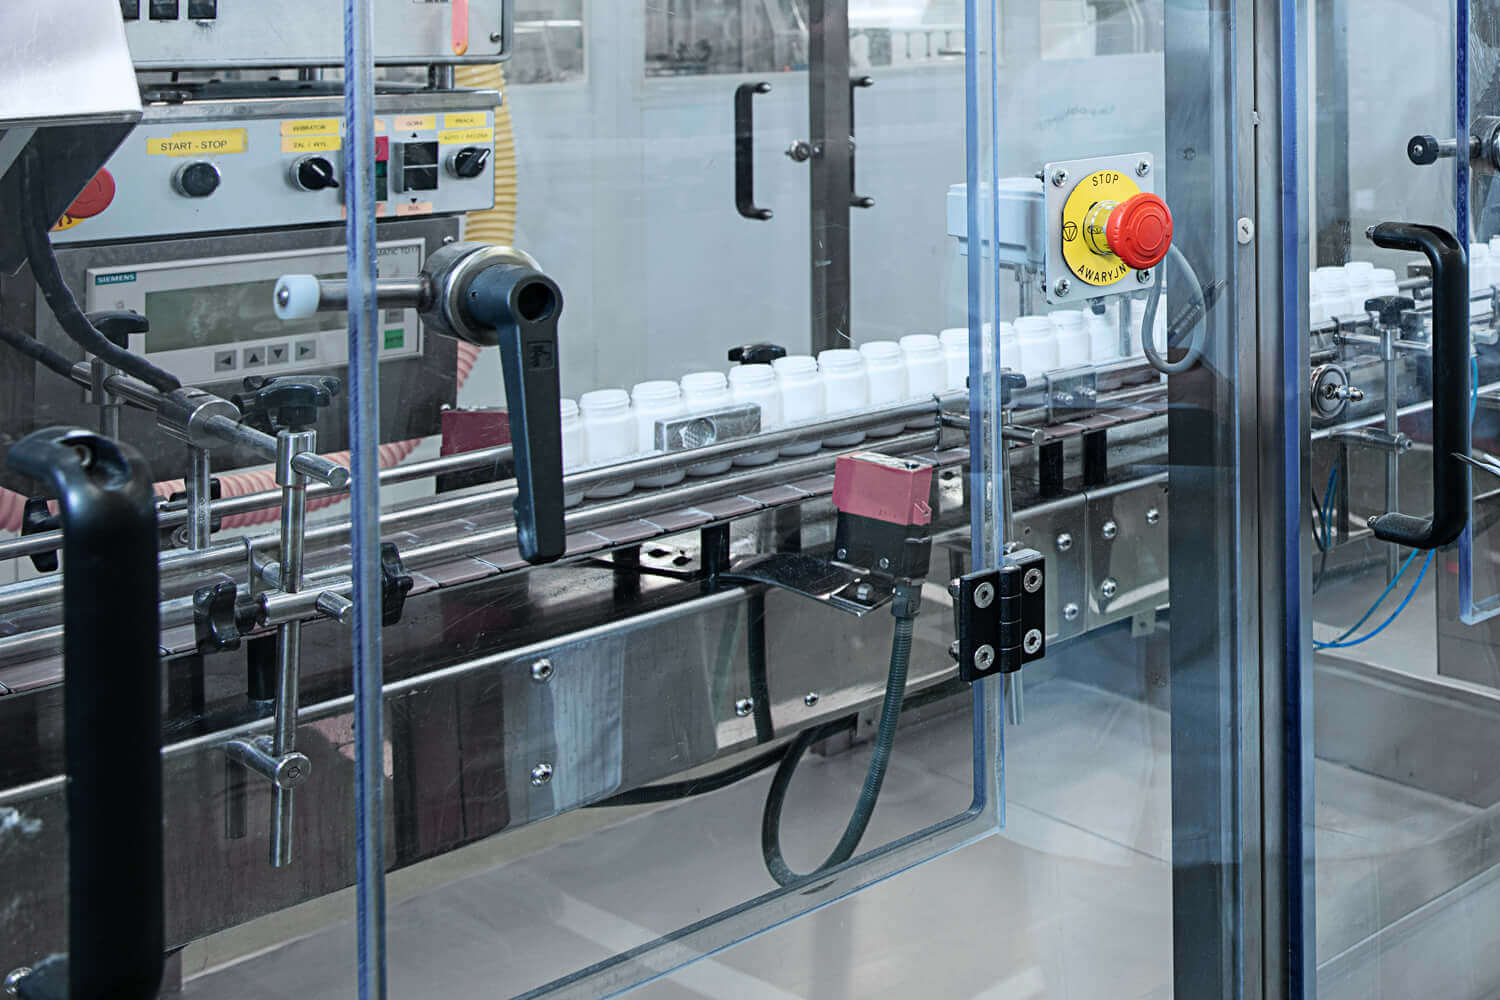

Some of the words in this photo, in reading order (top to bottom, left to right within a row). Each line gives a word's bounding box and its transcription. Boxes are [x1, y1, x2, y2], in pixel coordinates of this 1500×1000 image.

[160, 142, 192, 152] START
[200, 140, 228, 150] STOP
[1092, 173, 1119, 187] STOP
[96, 273, 135, 284] SIEMENS
[1077, 263, 1127, 283] AWARYJN
